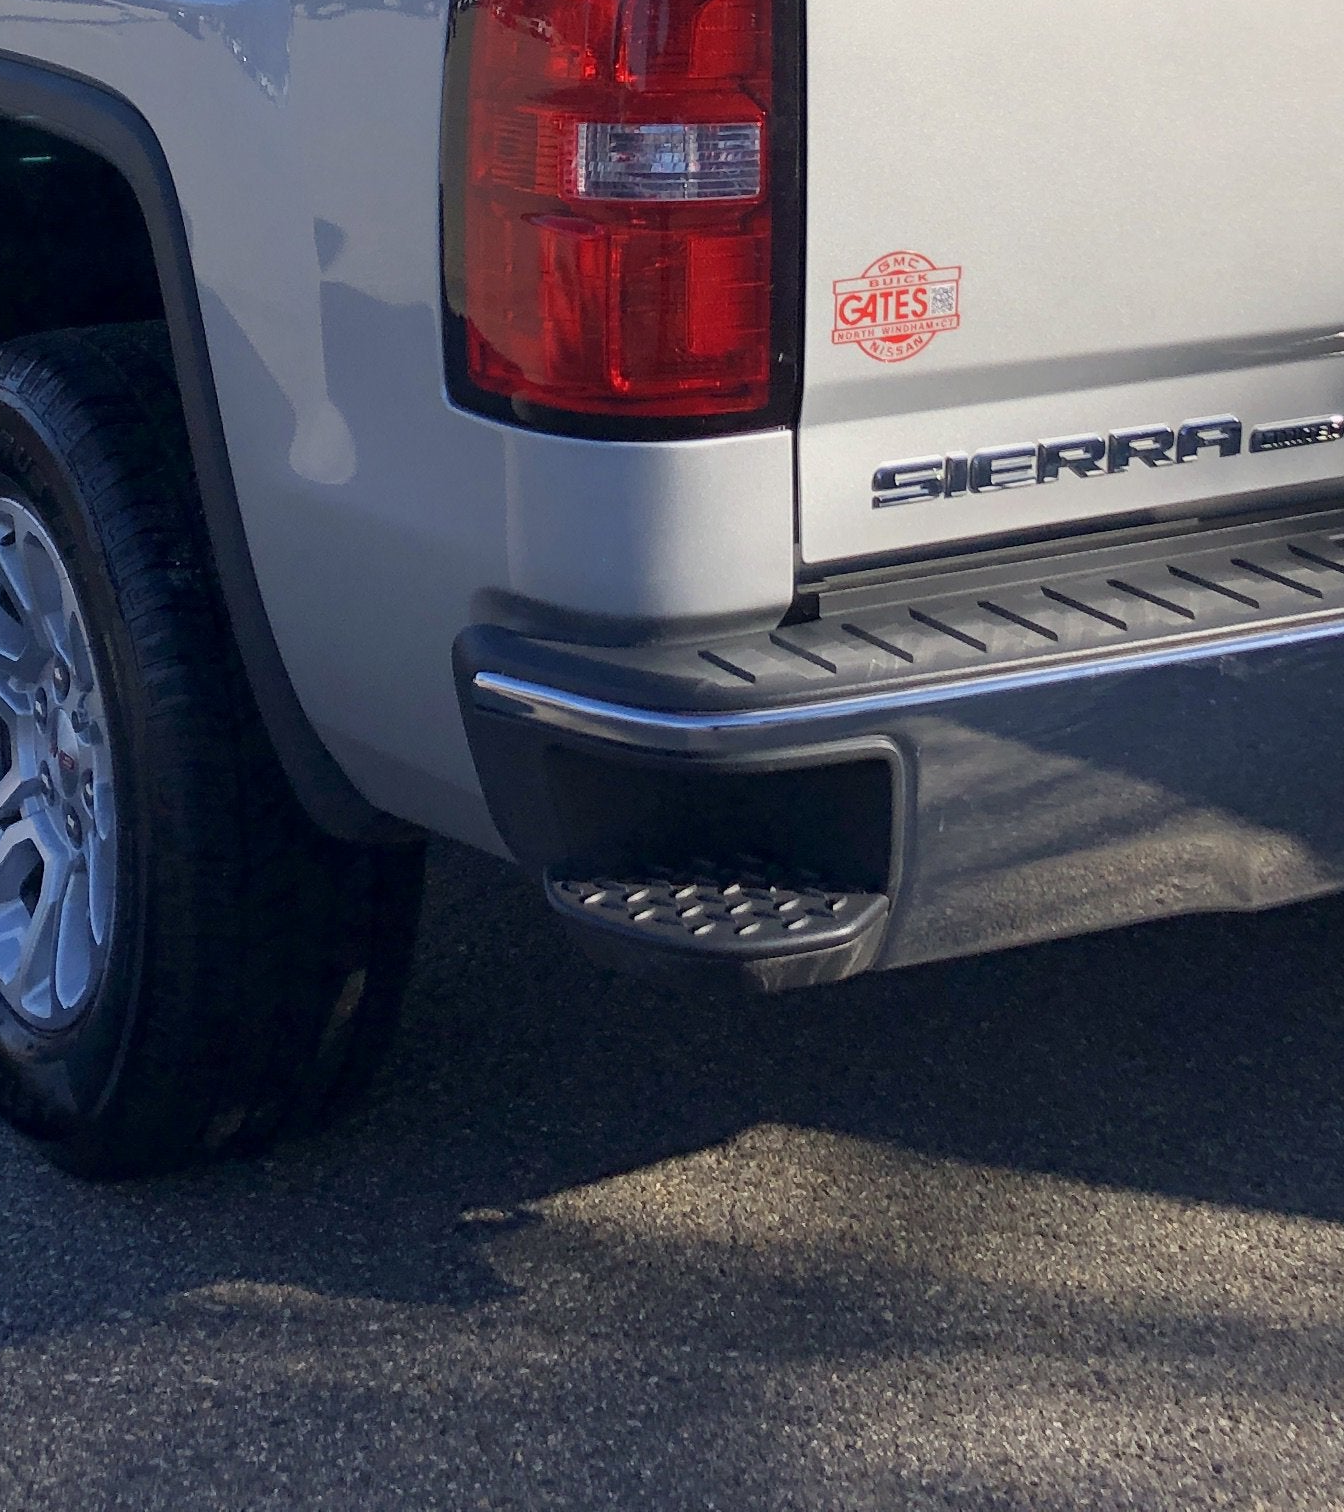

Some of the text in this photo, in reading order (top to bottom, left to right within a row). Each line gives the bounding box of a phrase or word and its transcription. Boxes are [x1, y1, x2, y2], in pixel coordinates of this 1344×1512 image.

[877, 257, 920, 273] GMC
[869, 273, 928, 288] BUICK
[838, 287, 928, 326] GATES
[837, 330, 875, 341] NORTH
[869, 335, 924, 358] NISSAN
[871, 413, 1242, 509] SIERRA
